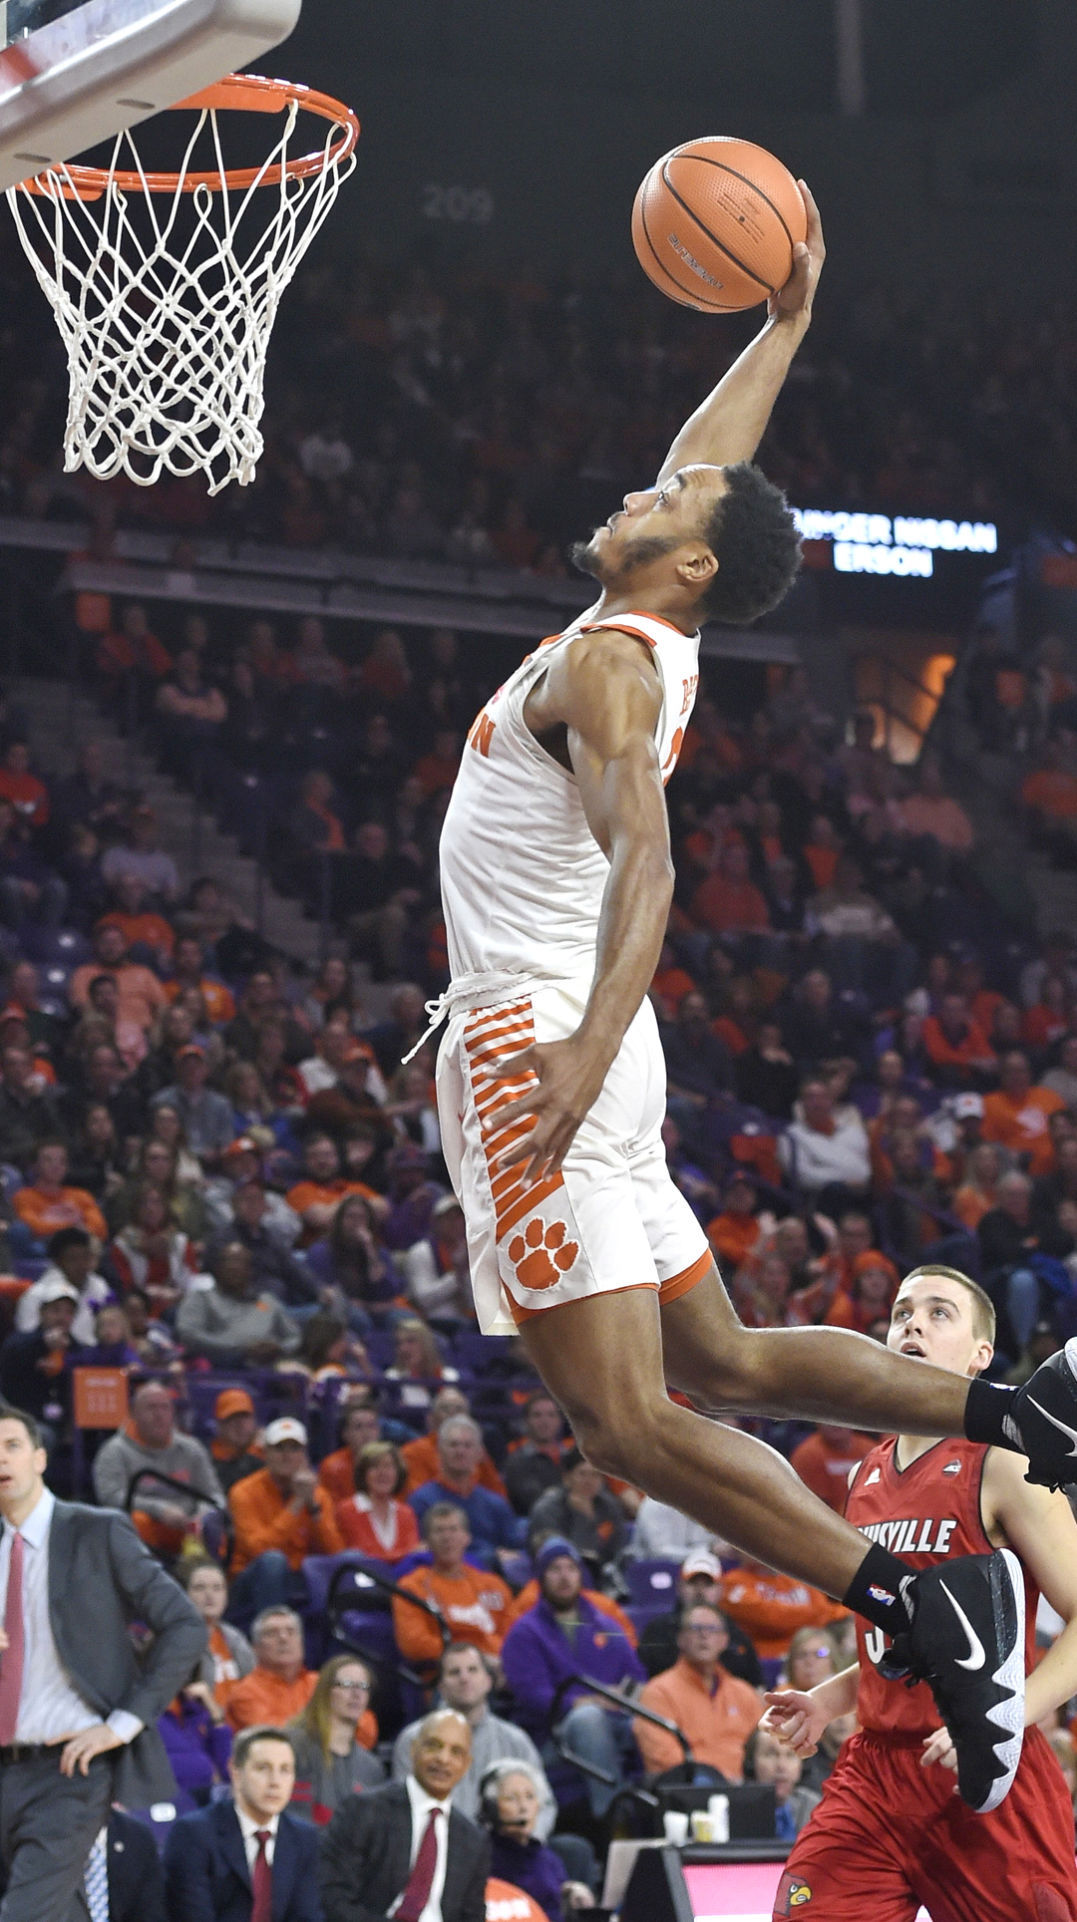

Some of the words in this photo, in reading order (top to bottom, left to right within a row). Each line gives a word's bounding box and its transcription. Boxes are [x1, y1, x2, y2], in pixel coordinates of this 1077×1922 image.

[423, 184, 495, 223] 209
[894, 516, 998, 553] NISSAN
[834, 541, 933, 578] ERSON
[857, 1518, 958, 1553] UISVILLE
